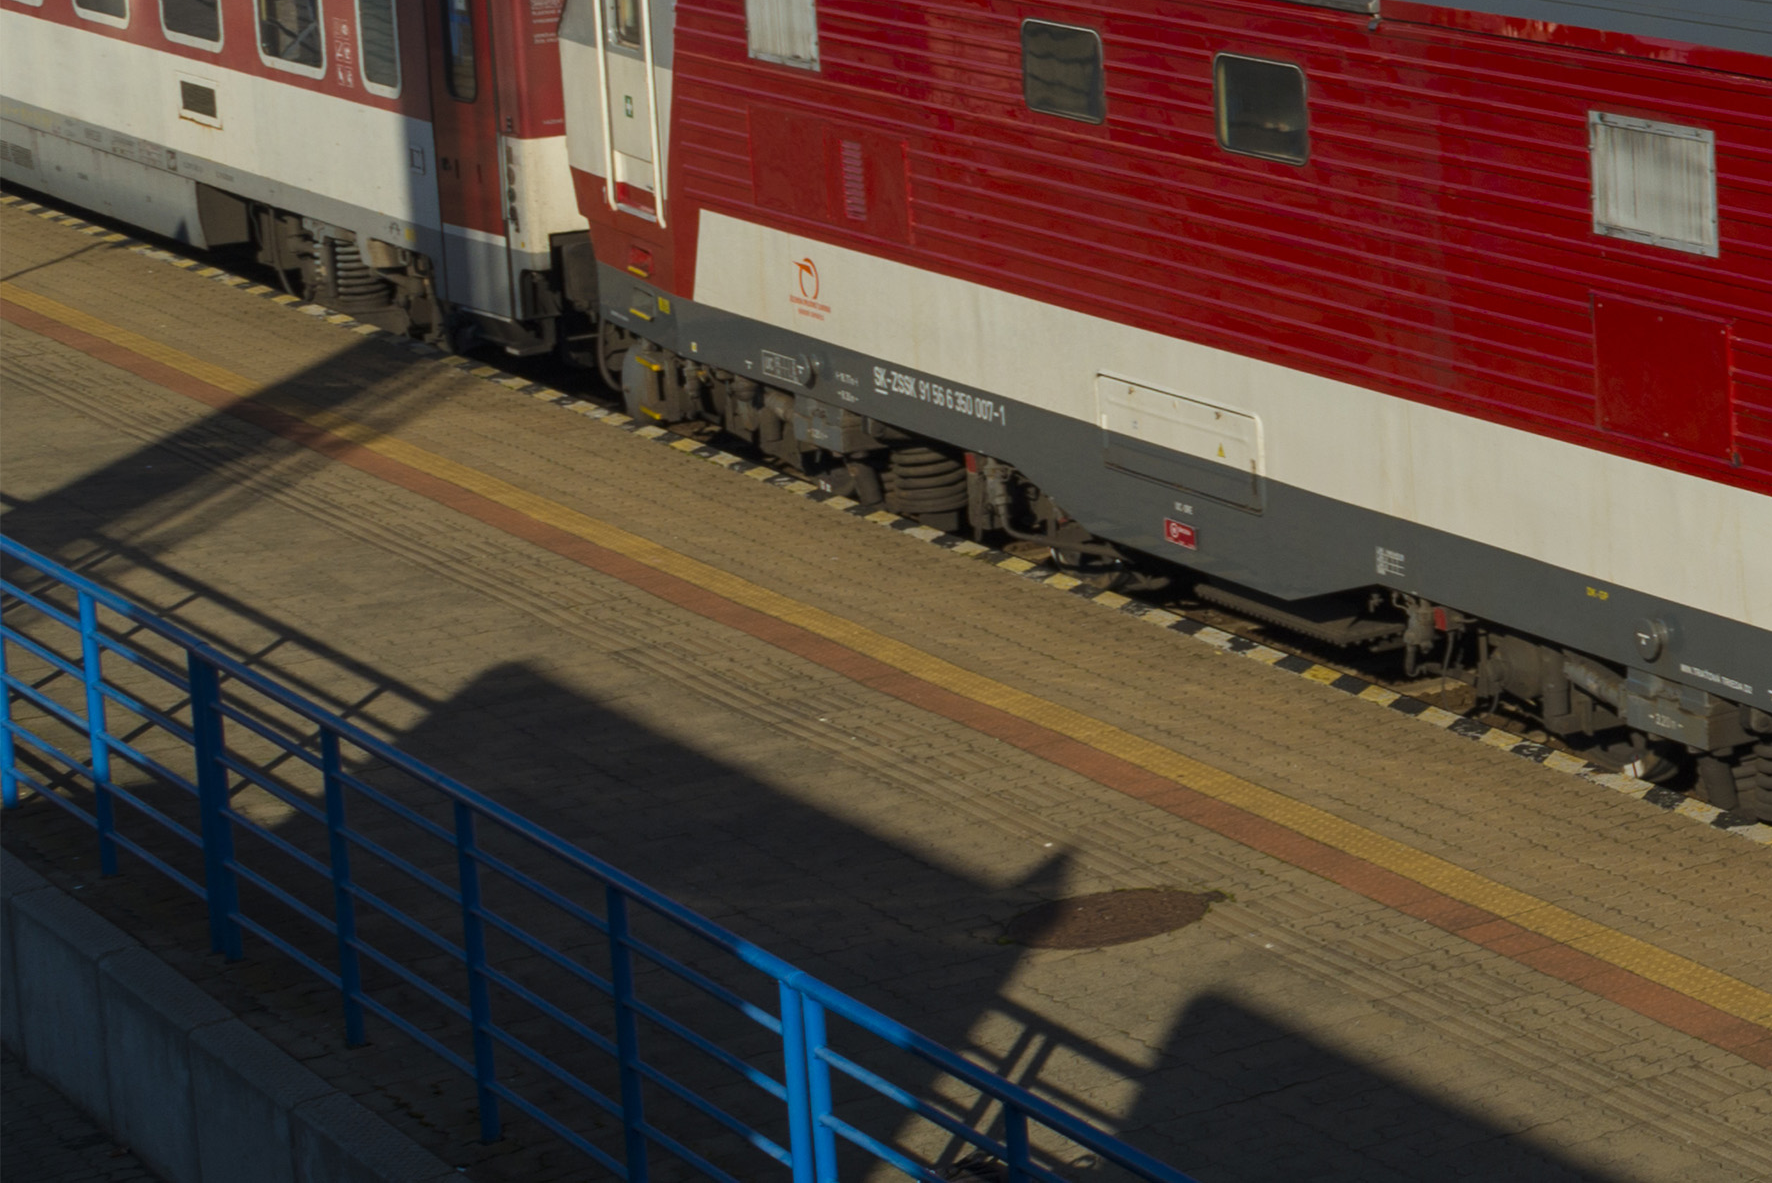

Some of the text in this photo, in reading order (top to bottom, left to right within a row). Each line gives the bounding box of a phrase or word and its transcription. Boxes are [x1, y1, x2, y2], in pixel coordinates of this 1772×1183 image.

[873, 366, 918, 398] SK-ZSSK
[919, 380, 931, 402] 91
[932, 384, 945, 406] 56
[946, 388, 954, 409] 6
[954, 391, 973, 415] 350
[975, 397, 1006, 426] 007-1
